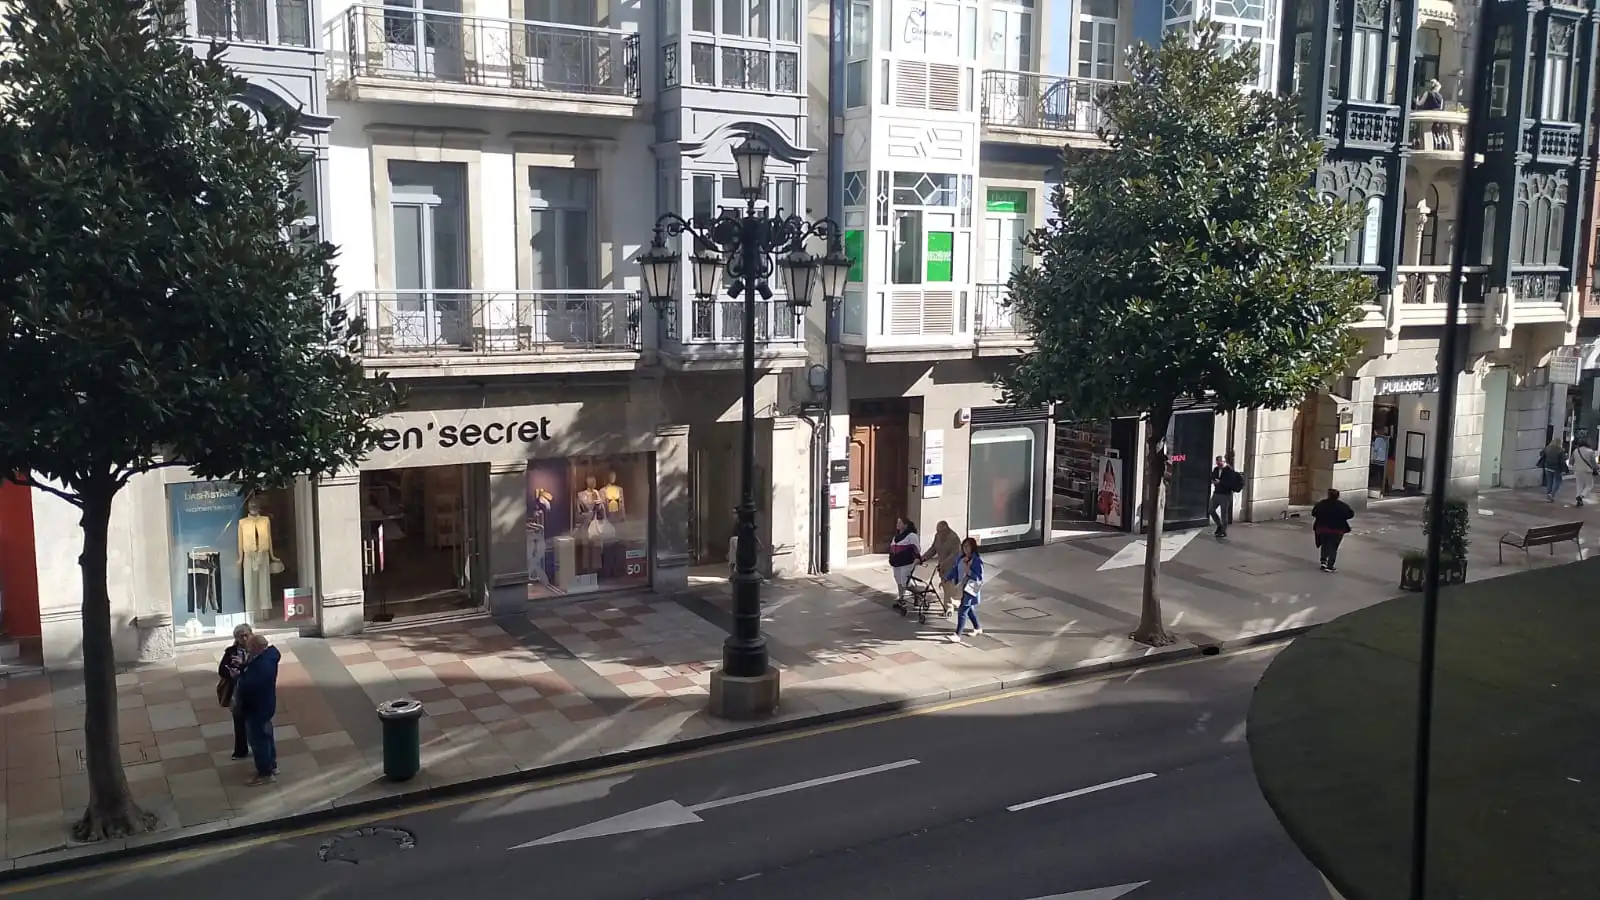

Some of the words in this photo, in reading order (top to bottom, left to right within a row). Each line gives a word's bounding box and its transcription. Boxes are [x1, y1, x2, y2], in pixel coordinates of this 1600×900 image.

[377, 416, 552, 451] en'secret
[627, 563, 641, 576] 50
[287, 603, 305, 617] 50
